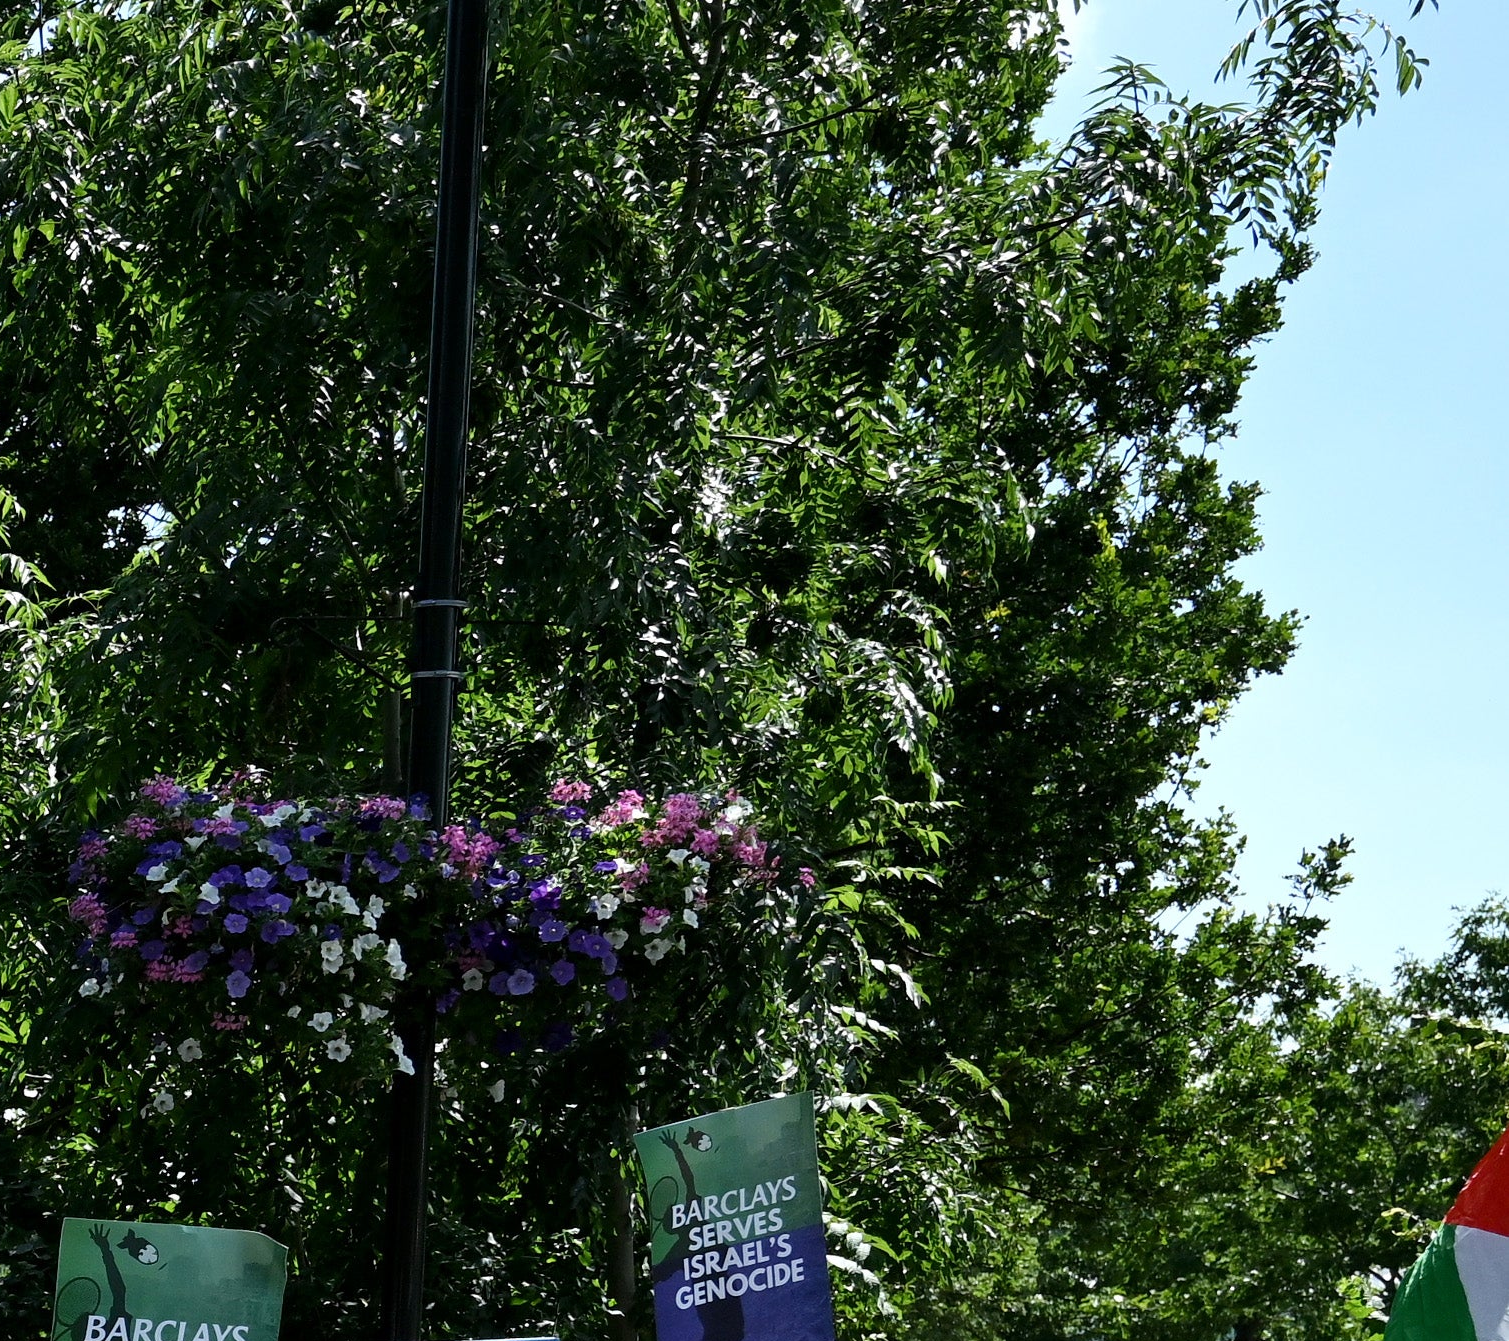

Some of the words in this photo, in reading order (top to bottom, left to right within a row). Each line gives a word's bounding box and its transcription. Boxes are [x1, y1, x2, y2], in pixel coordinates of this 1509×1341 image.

[672, 1176, 797, 1230] BARCLAYS
[688, 1208, 783, 1251] SERVES
[684, 1234, 792, 1281] ISRAEL'S
[675, 1258, 805, 1310] GENOCIDE
